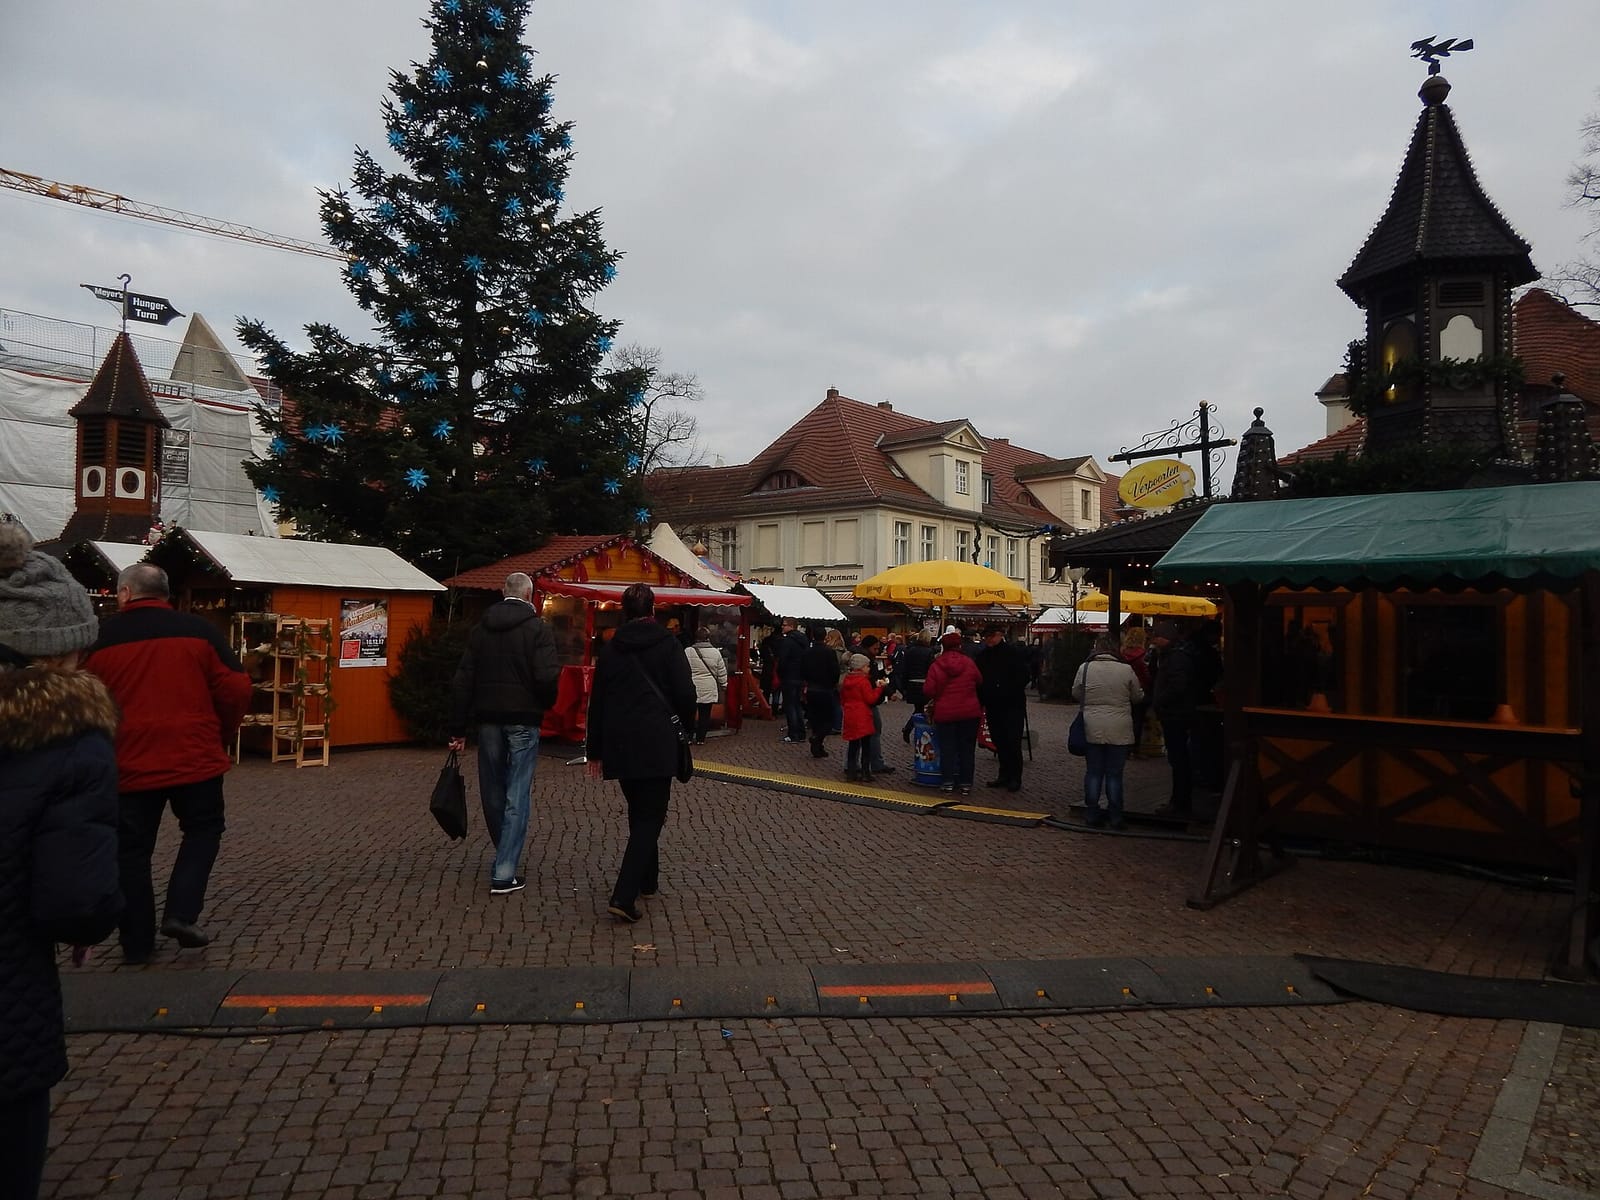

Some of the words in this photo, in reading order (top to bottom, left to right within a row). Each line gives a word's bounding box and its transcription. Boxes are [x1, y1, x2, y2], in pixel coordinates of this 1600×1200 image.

[132, 297, 168, 311] Hunger-
[135, 308, 159, 321] Turm
[1127, 465, 1180, 498] Verpoorten
[823, 573, 858, 584] Apartments
